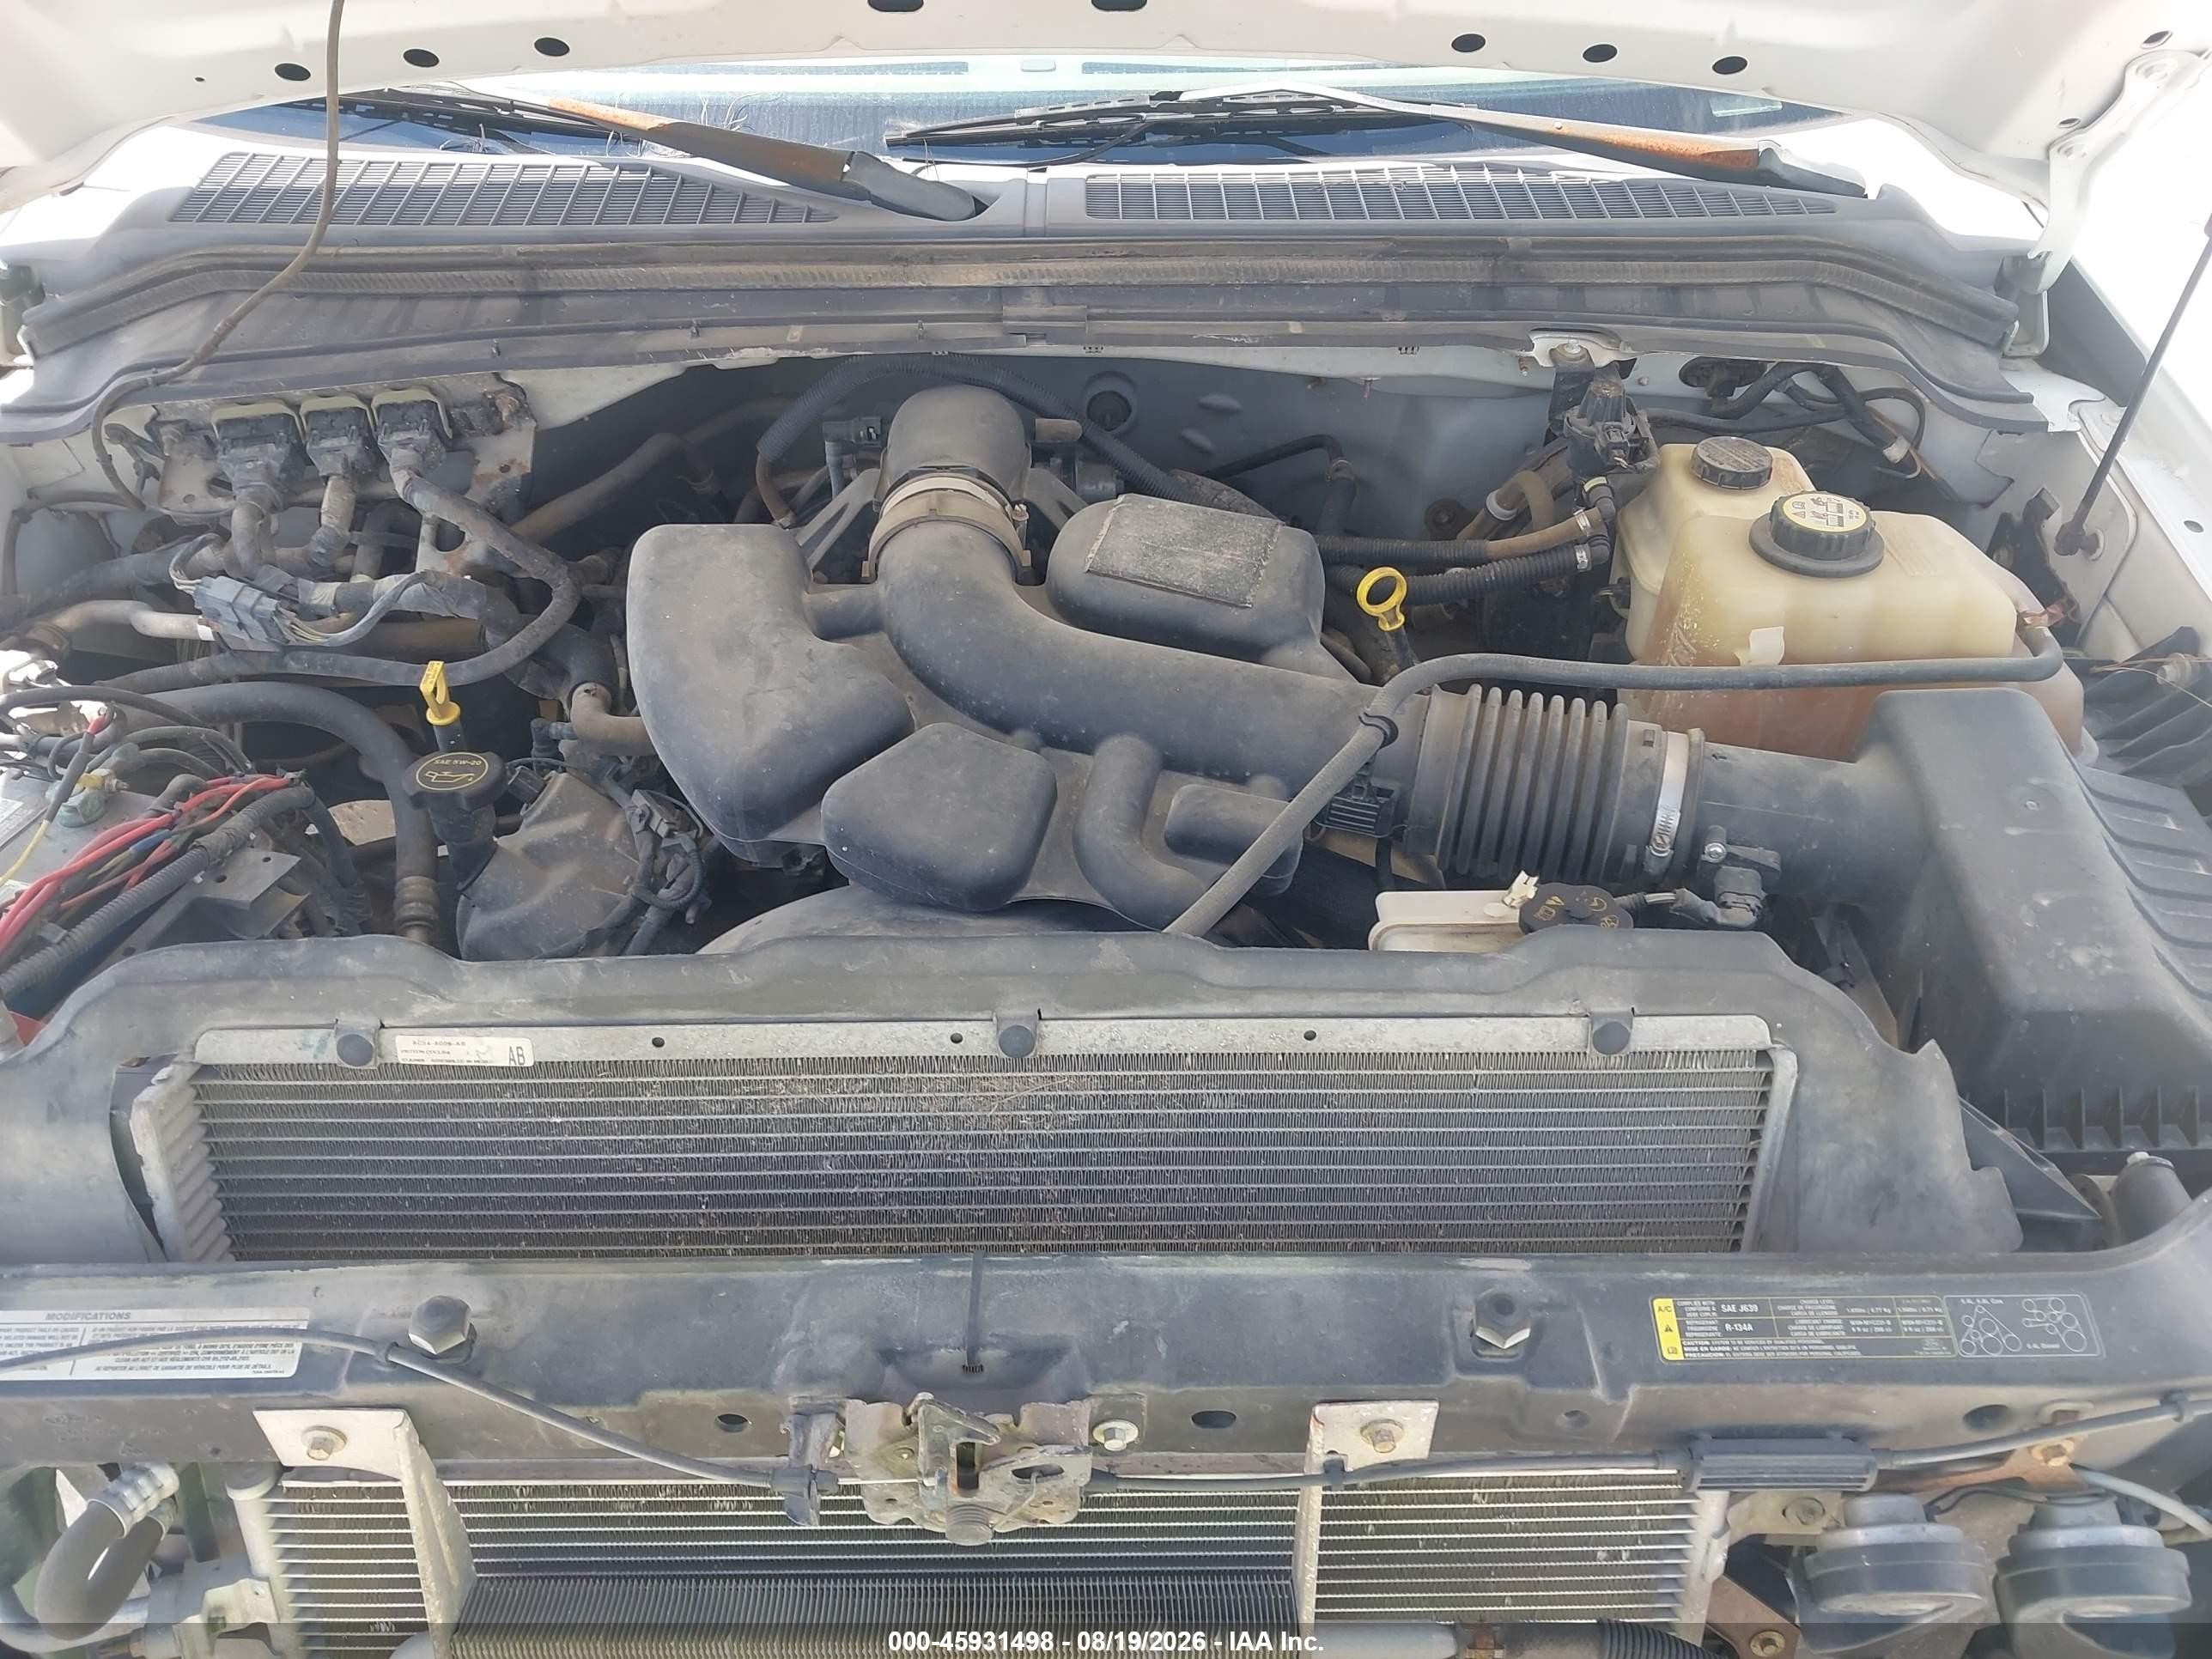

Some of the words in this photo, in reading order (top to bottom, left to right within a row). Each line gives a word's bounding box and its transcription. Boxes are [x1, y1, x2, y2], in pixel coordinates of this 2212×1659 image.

[508, 1046, 526, 1066] AB
[1721, 1304, 1737, 1313] SAE
[1739, 1304, 1759, 1313] J639
[46, 1312, 131, 1321] MODIFICATIONS
[1724, 1323, 1753, 1332] R-134A
